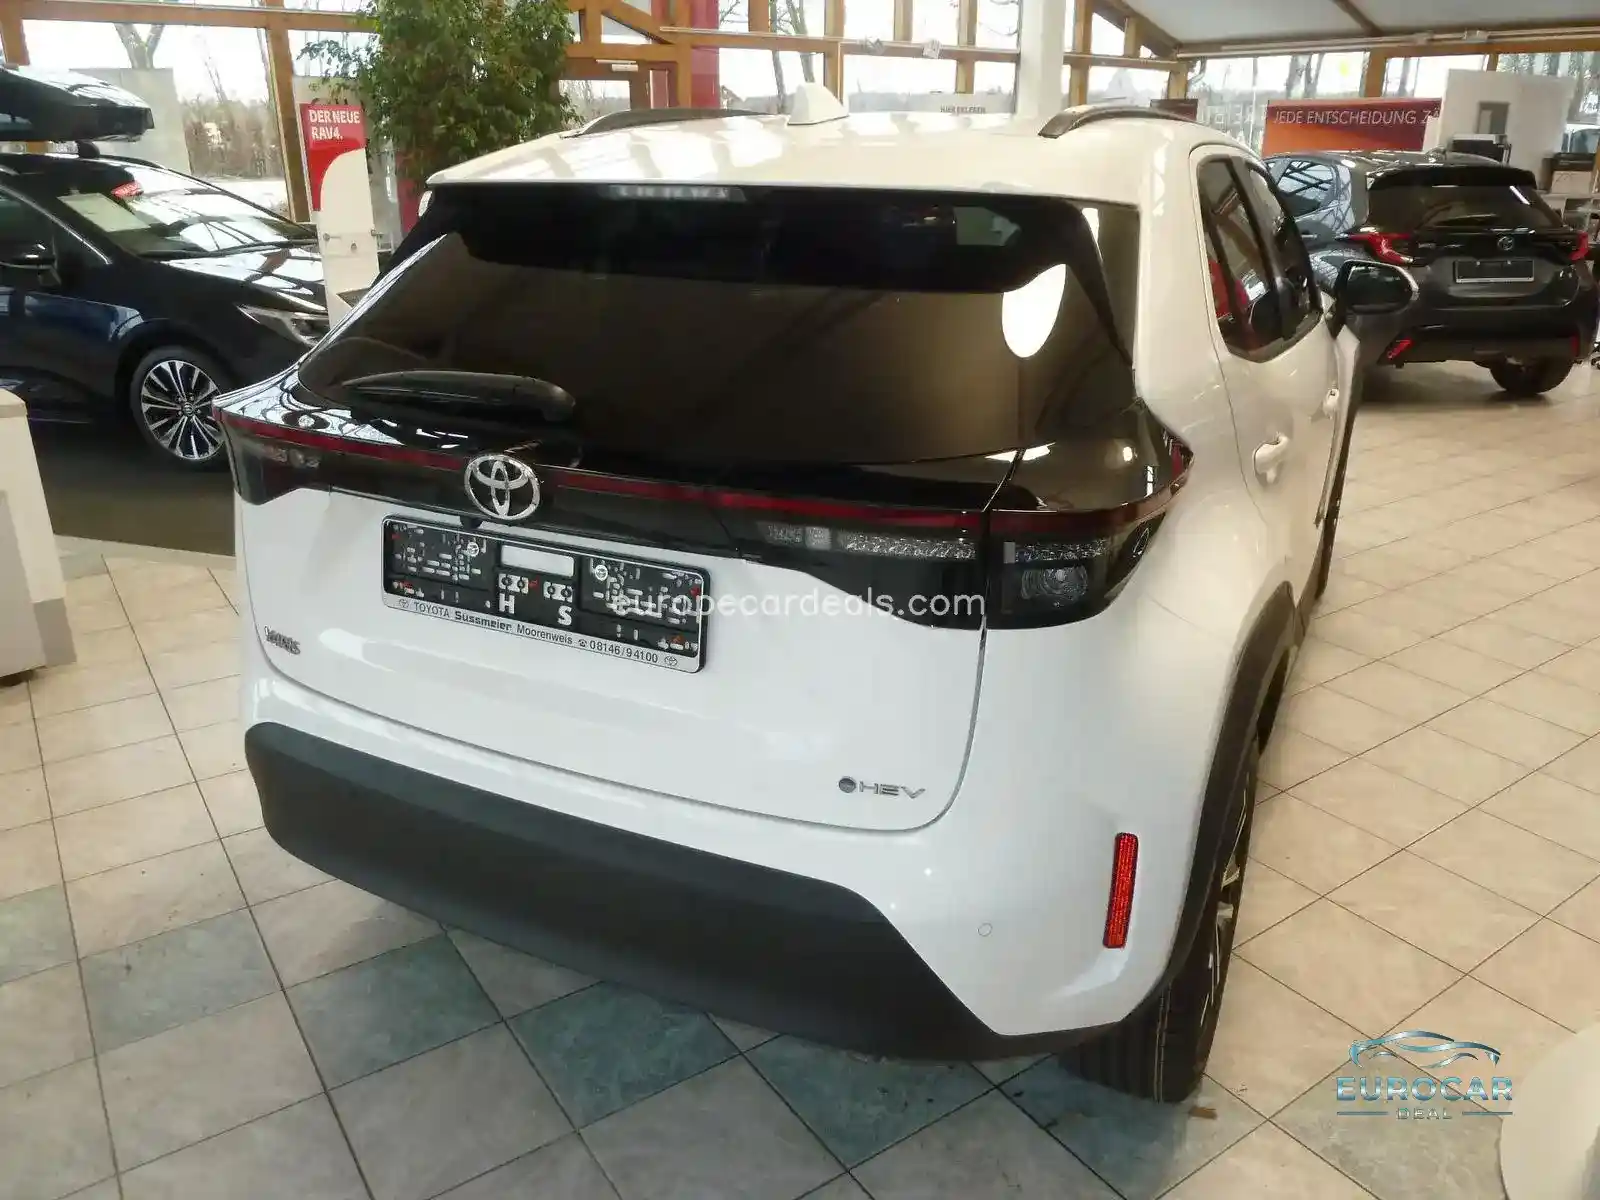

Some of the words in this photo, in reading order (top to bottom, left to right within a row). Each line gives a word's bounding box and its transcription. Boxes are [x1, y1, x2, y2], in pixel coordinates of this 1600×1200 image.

[309, 109, 331, 123] DER
[332, 110, 360, 123] NEUE
[1274, 110, 1303, 124] JEDE
[1307, 110, 1417, 125] ENTSCHEIDUNG
[311, 126, 343, 140] RAV4.
[414, 601, 450, 618] TOYOTA
[516, 623, 573, 645] Moorenweis
[589, 639, 658, 664] 08146/94100
[859, 780, 926, 799] HEV
